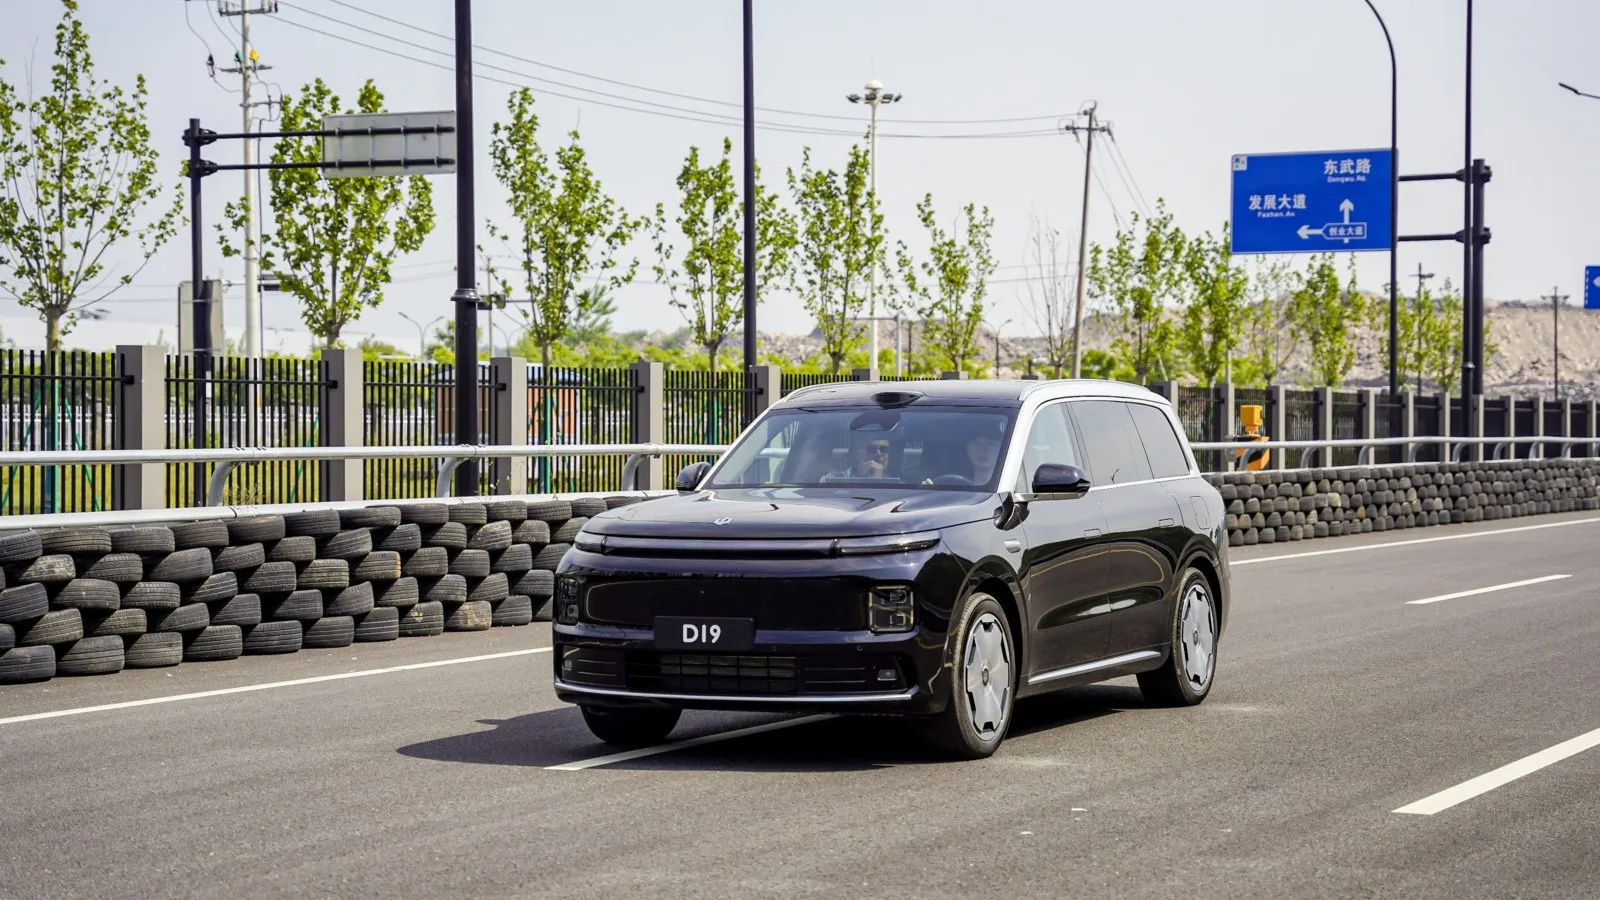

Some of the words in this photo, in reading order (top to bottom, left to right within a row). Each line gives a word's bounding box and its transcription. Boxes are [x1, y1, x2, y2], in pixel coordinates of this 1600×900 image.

[1324, 158, 1371, 175] 东武路
[1249, 193, 1306, 210] 发展大道
[682, 624, 721, 643] D19
